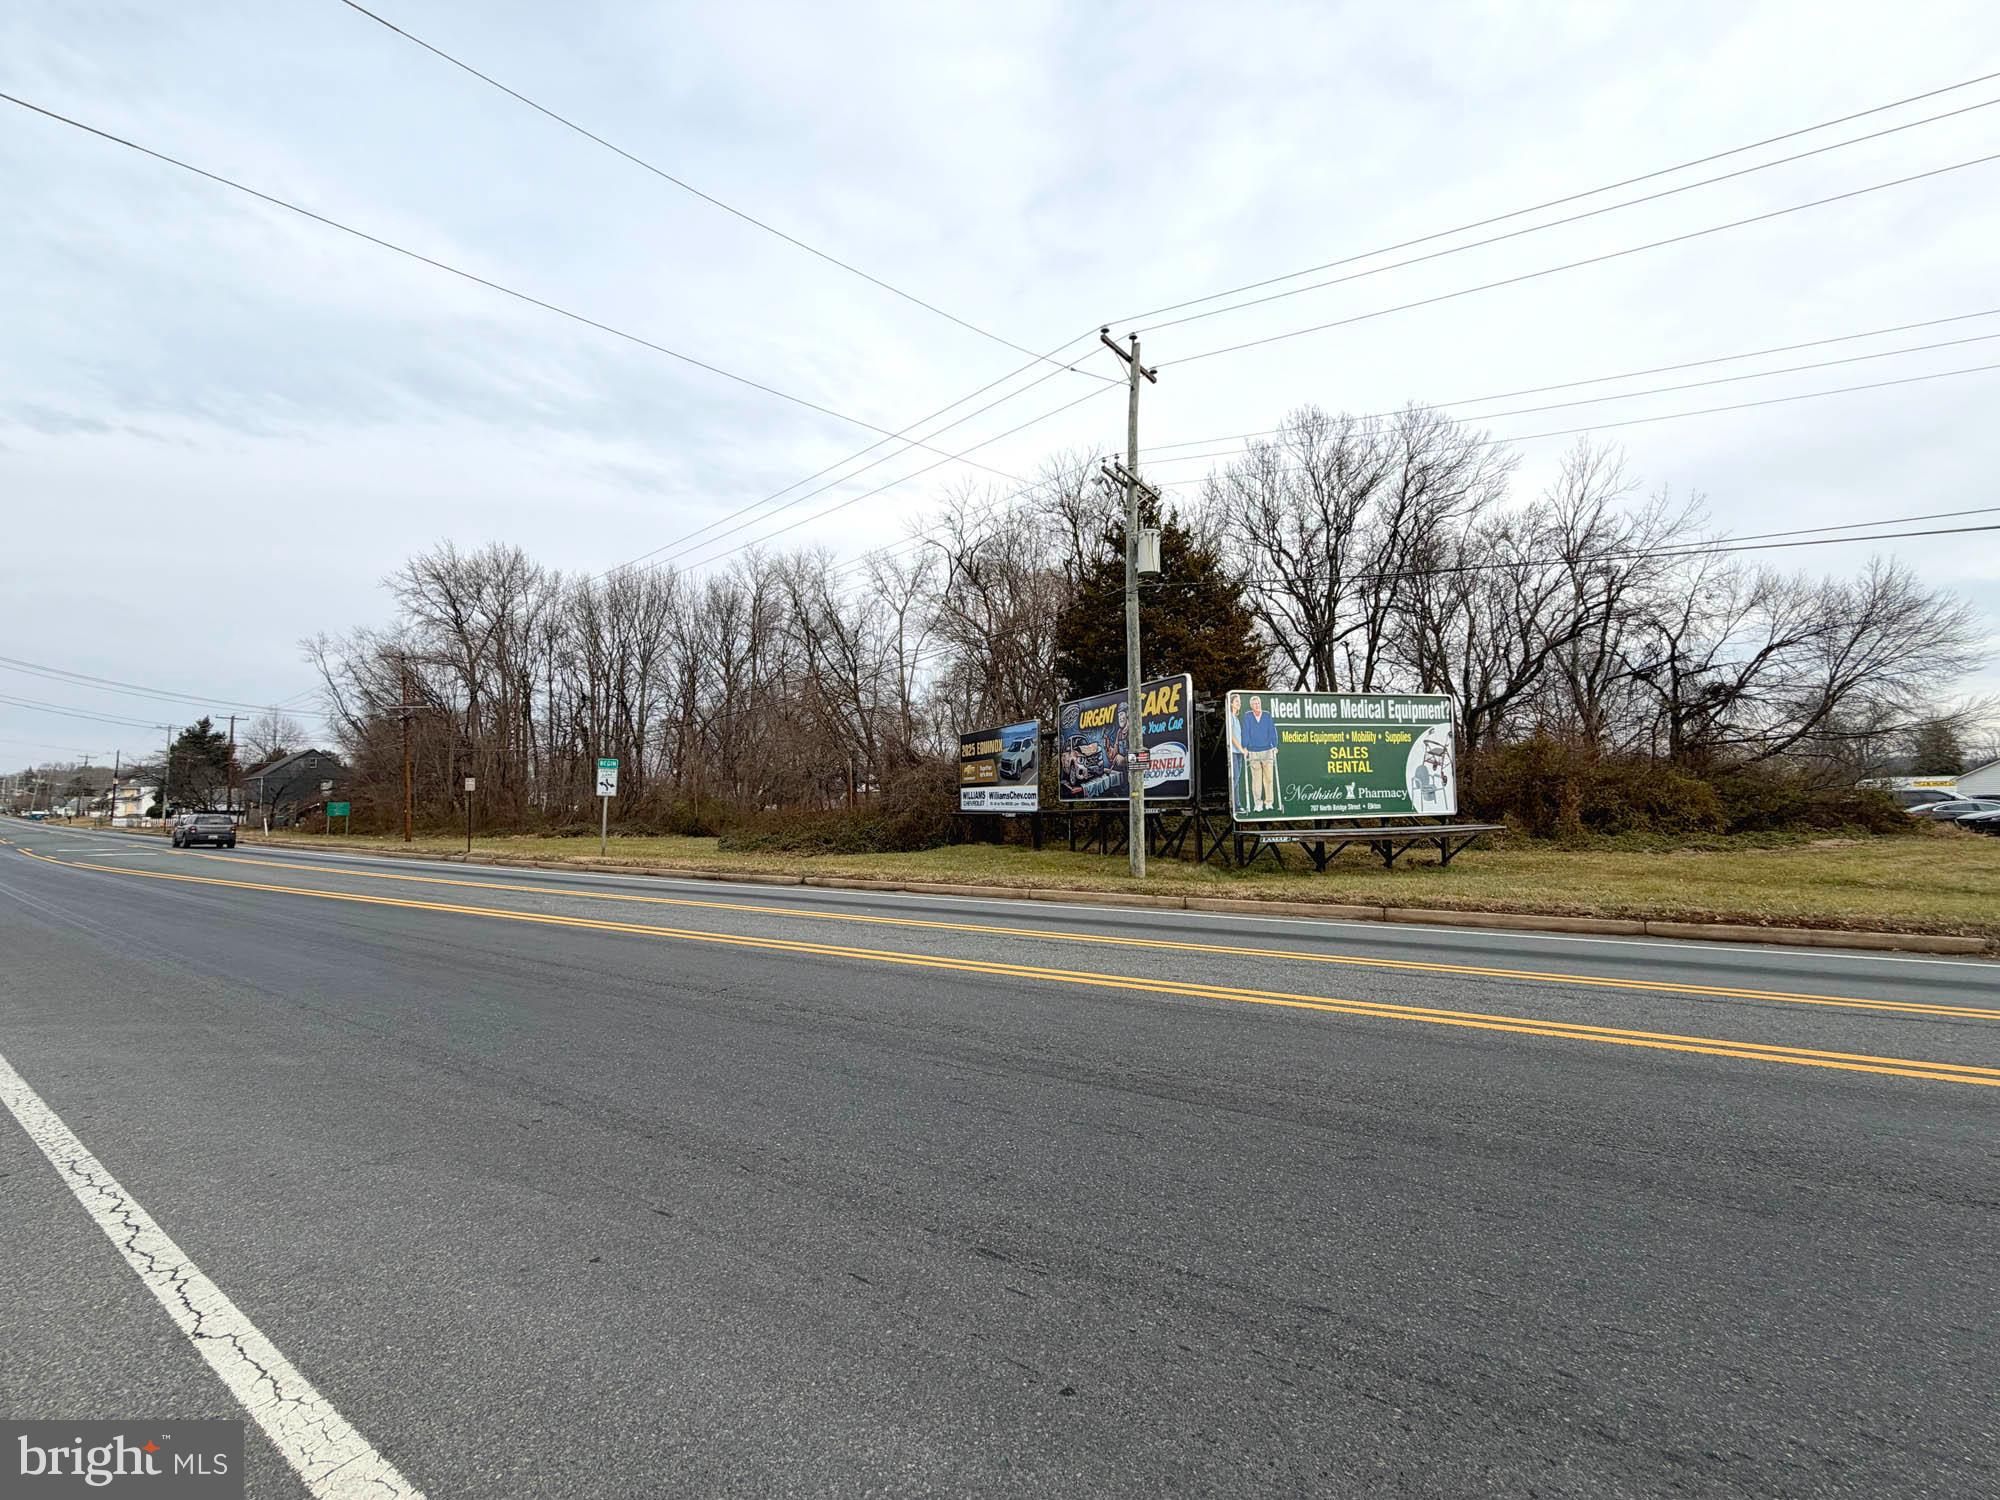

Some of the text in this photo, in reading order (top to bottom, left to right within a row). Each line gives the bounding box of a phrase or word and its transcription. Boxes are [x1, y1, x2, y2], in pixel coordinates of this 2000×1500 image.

[1080, 703, 1117, 729] URGENT
[1271, 698, 1451, 723] Need Home Medical Equipment?
[1282, 731, 1412, 745] Medical Equipment Mobility Supplies
[1330, 747, 1369, 759] SALES
[1328, 760, 1373, 774] RENTAL
[963, 790, 985, 800] WILLIAMS
[1284, 783, 1408, 802] Northside Pharmacy
